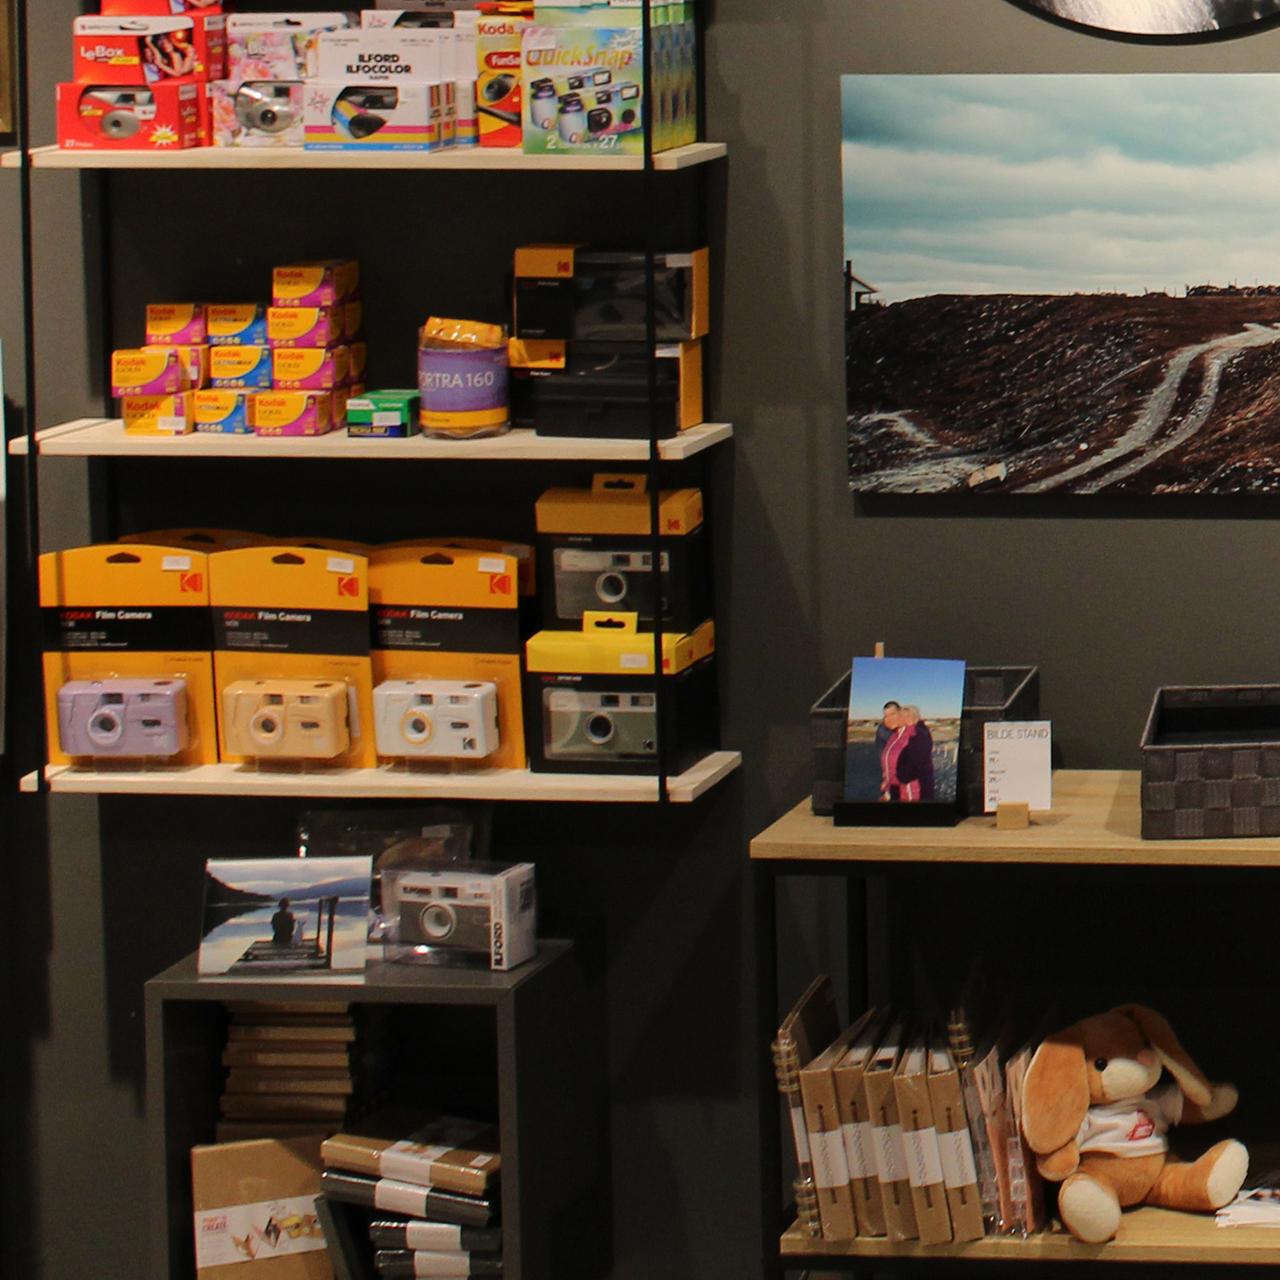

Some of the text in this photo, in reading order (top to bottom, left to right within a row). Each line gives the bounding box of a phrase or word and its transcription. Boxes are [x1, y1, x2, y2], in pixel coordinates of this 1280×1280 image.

[80, 45, 124, 61] LeBox
[358, 53, 400, 64] ILFORD
[525, 44, 634, 70] QuickSnap
[346, 64, 412, 75] ILFOCOLOR
[600, 134, 618, 148] 27
[213, 350, 240, 359] Kodak
[277, 352, 304, 361] Kodak
[116, 358, 145, 367] Kodak
[419, 371, 495, 388] ORTRA 160
[126, 402, 160, 411] Kodak
[258, 399, 287, 408] Kodak
[96, 611, 116, 620] Film
[118, 611, 153, 621] Camera
[258, 611, 277, 620] Film
[279, 613, 312, 622] Camera
[410, 610, 430, 619] Film
[431, 611, 464, 621] Camera
[987, 727, 1049, 740] BILDE STAND
[403, 886, 432, 896] ILFORD
[493, 922, 504, 966] ILFORD
